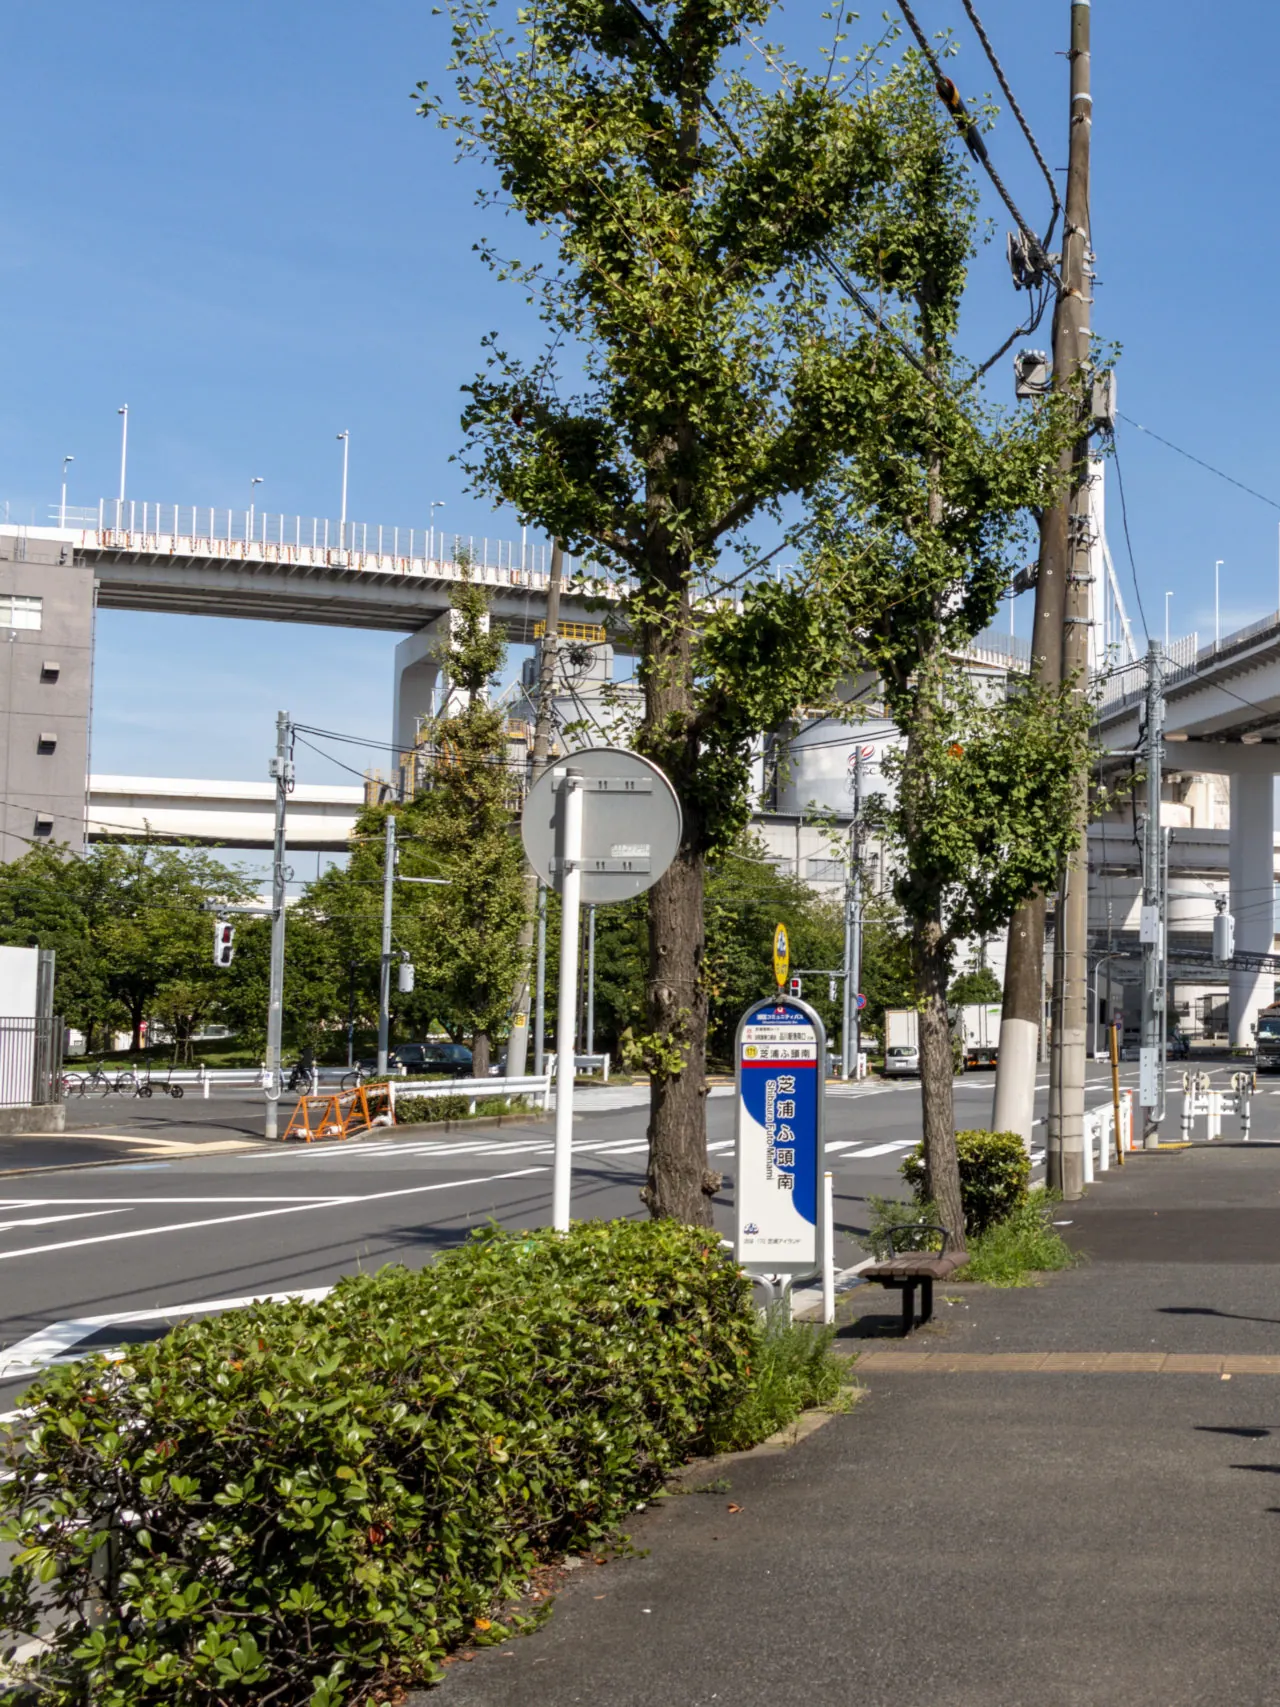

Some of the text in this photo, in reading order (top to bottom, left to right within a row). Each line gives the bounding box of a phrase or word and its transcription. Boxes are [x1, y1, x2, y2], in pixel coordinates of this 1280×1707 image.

[760, 1049, 810, 1059] 芝浦ふ頭南
[765, 1079, 777, 1122] Shibaura
[777, 1075, 795, 1190] 芝浦ふ頭南
